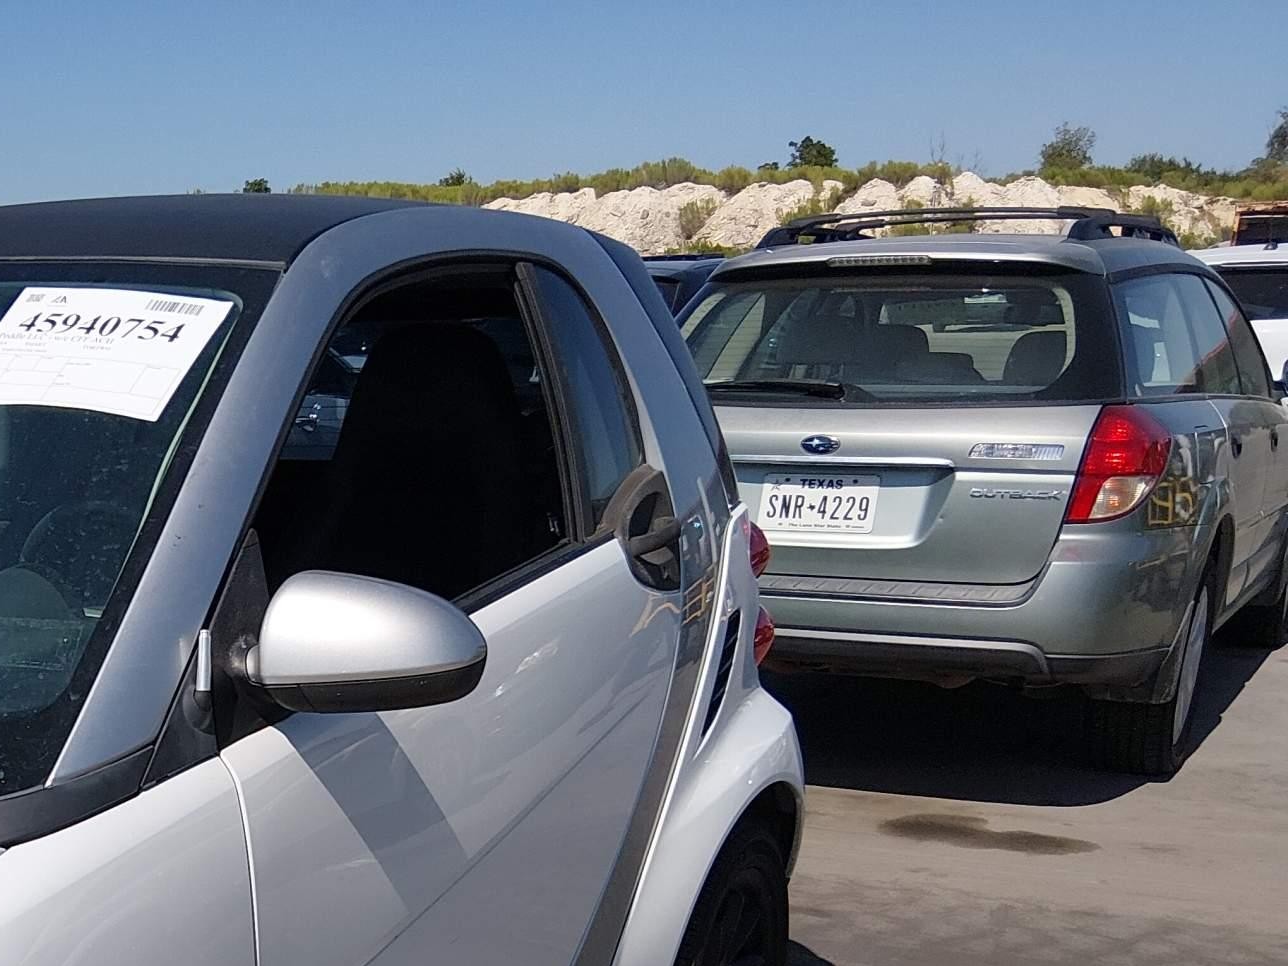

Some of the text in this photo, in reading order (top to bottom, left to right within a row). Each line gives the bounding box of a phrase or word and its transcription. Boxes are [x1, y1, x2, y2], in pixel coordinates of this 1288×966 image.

[19, 312, 186, 343] 45940754
[800, 479, 843, 489] TEXAS
[970, 488, 1061, 500] OUTBACK
